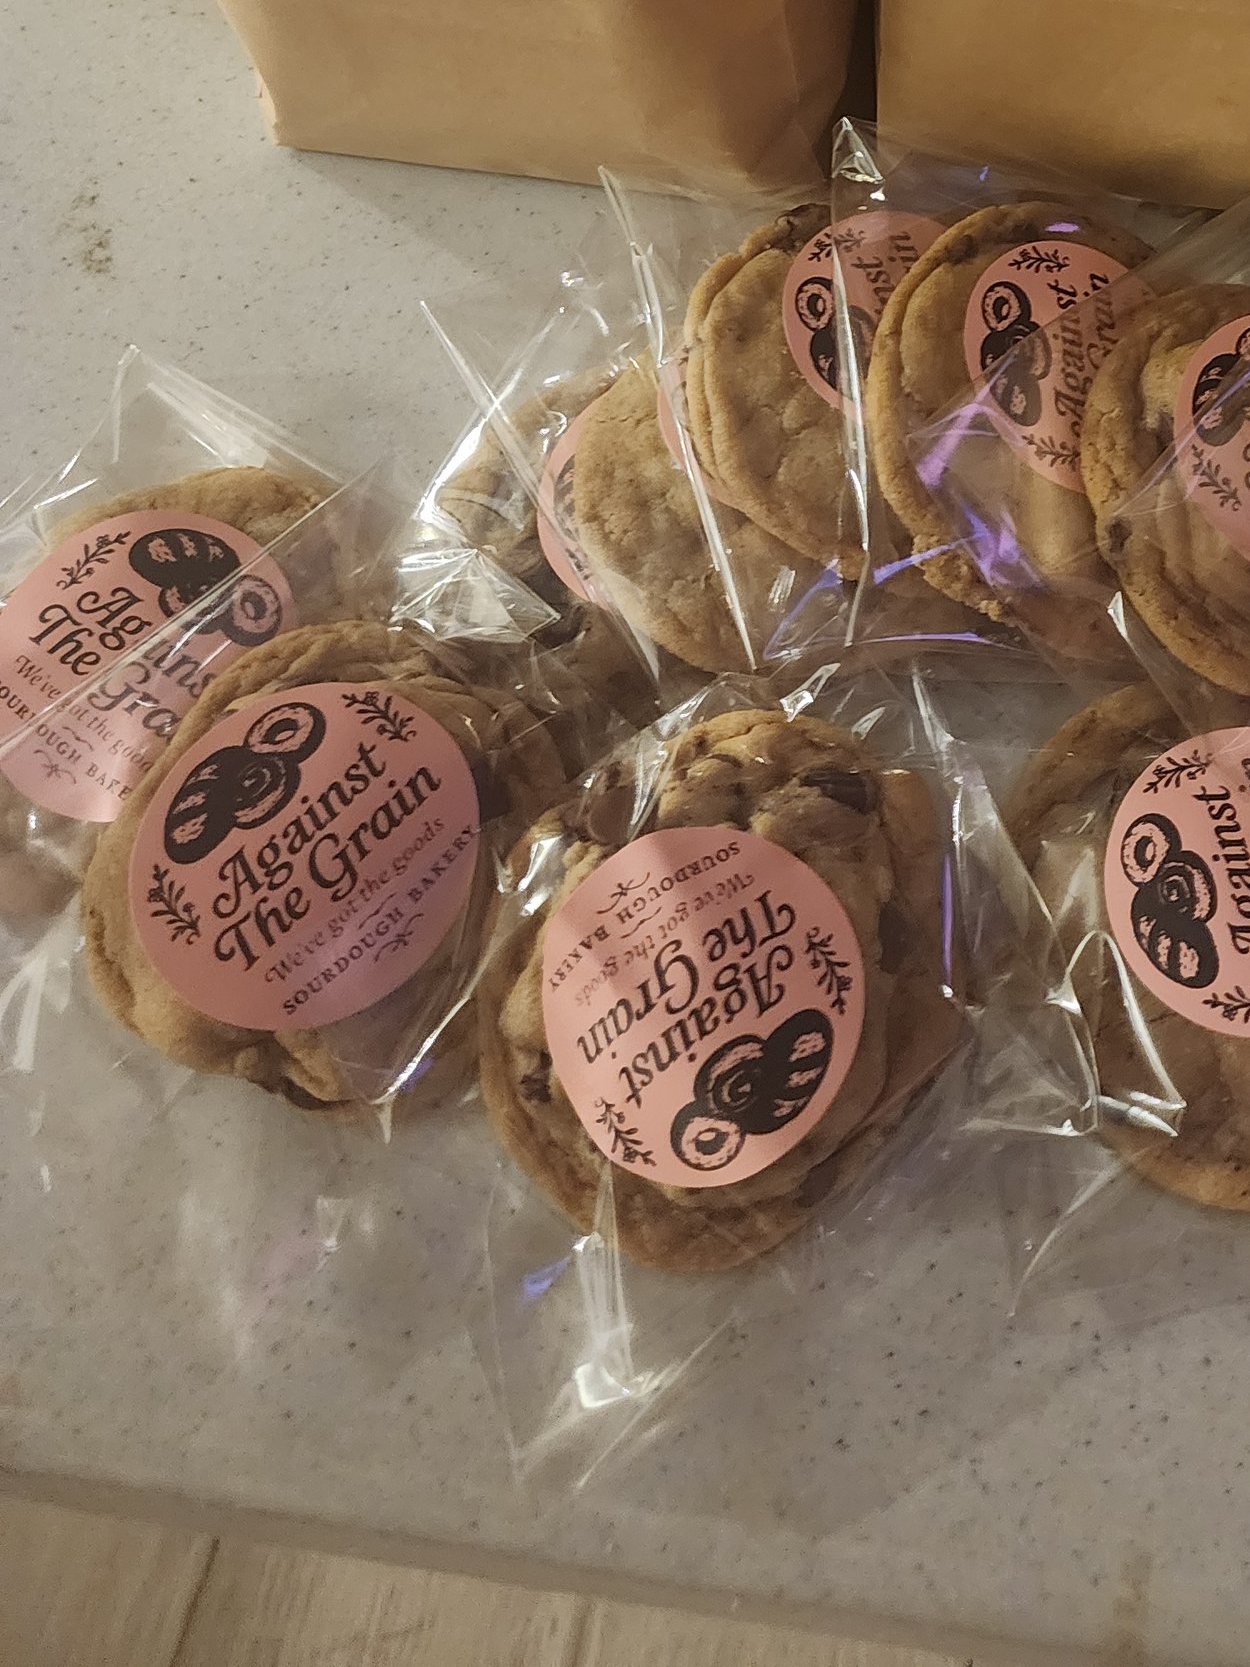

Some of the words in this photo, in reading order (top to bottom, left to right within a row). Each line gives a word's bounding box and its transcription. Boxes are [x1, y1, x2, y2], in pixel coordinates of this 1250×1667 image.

[29, 603, 102, 677] The
[211, 741, 388, 920] Against
[214, 886, 311, 972] The
[308, 766, 442, 903] Grain
[615, 841, 741, 925] SOURDOUGH
[282, 906, 404, 1016] SOURDOUGH
[407, 823, 479, 903] BAKERY
[548, 925, 611, 994] BAKERY
[703, 889, 798, 962] The
[575, 938, 701, 1064] Grain
[617, 944, 795, 1110] Against
